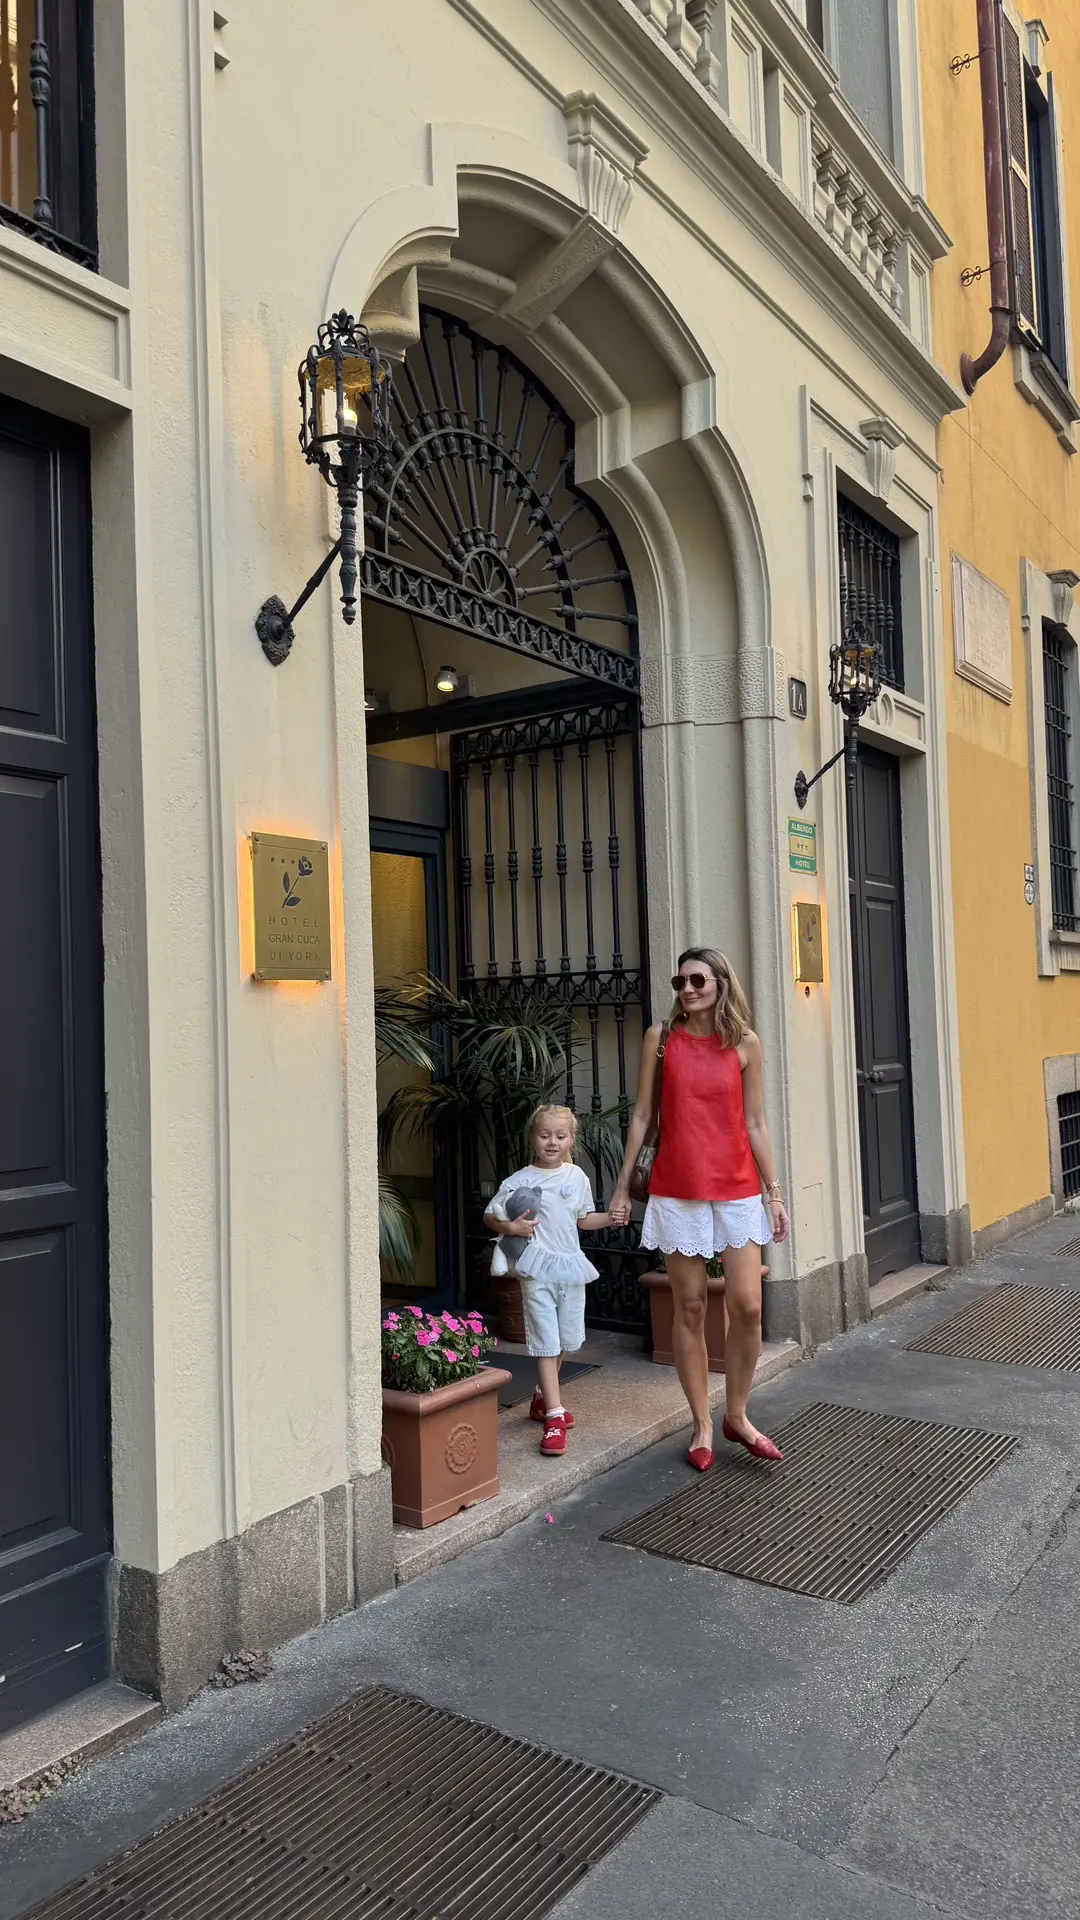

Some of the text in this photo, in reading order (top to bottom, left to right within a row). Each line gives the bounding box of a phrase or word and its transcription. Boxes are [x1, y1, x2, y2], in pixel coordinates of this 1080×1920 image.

[791, 683, 804, 711] 1A
[791, 822, 813, 834] ALBERGO
[795, 859, 811, 869] HOTEL
[268, 916, 319, 927] HOTEL
[268, 933, 320, 944] GRAN DUCA
[269, 951, 320, 961] DI YORK
